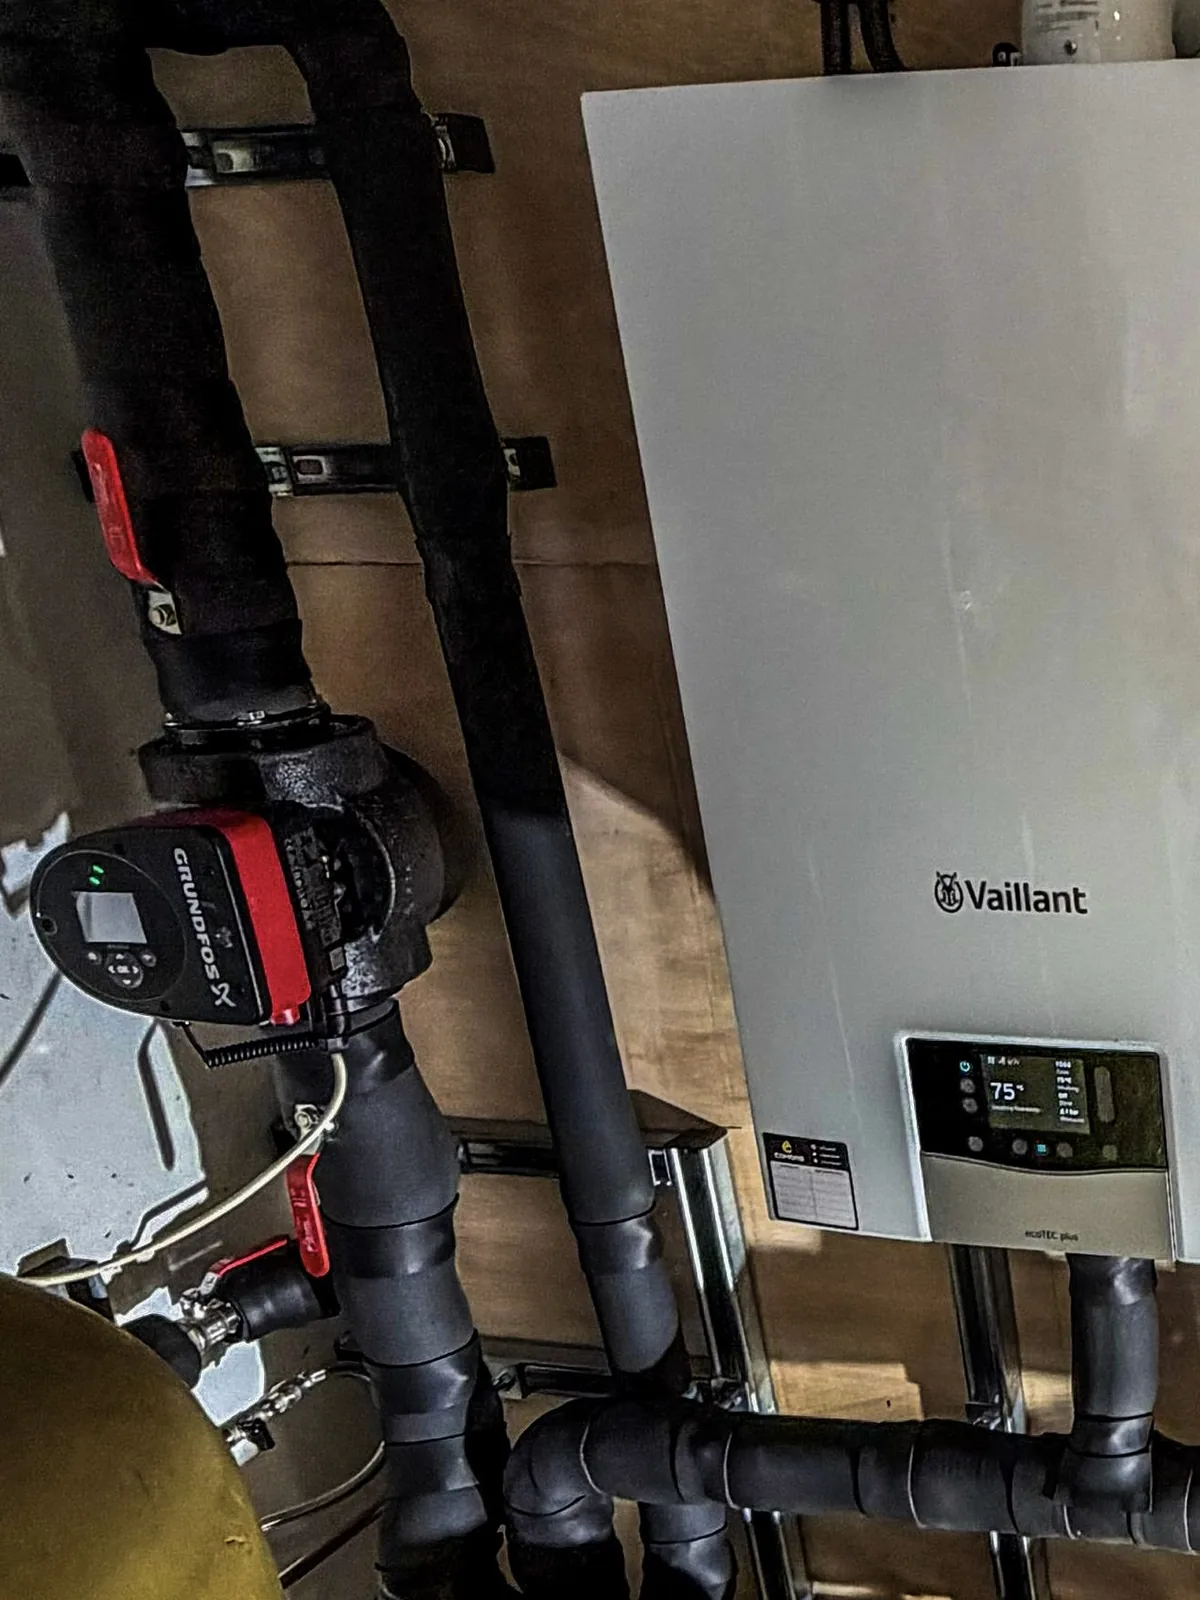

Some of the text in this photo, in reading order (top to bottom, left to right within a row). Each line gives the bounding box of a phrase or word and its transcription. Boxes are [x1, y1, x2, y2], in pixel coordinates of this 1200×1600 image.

[173, 847, 220, 980] GRUNDFOS
[964, 880, 1088, 914] Vaillant
[1025, 1230, 1079, 1242] ecoTEC plus
